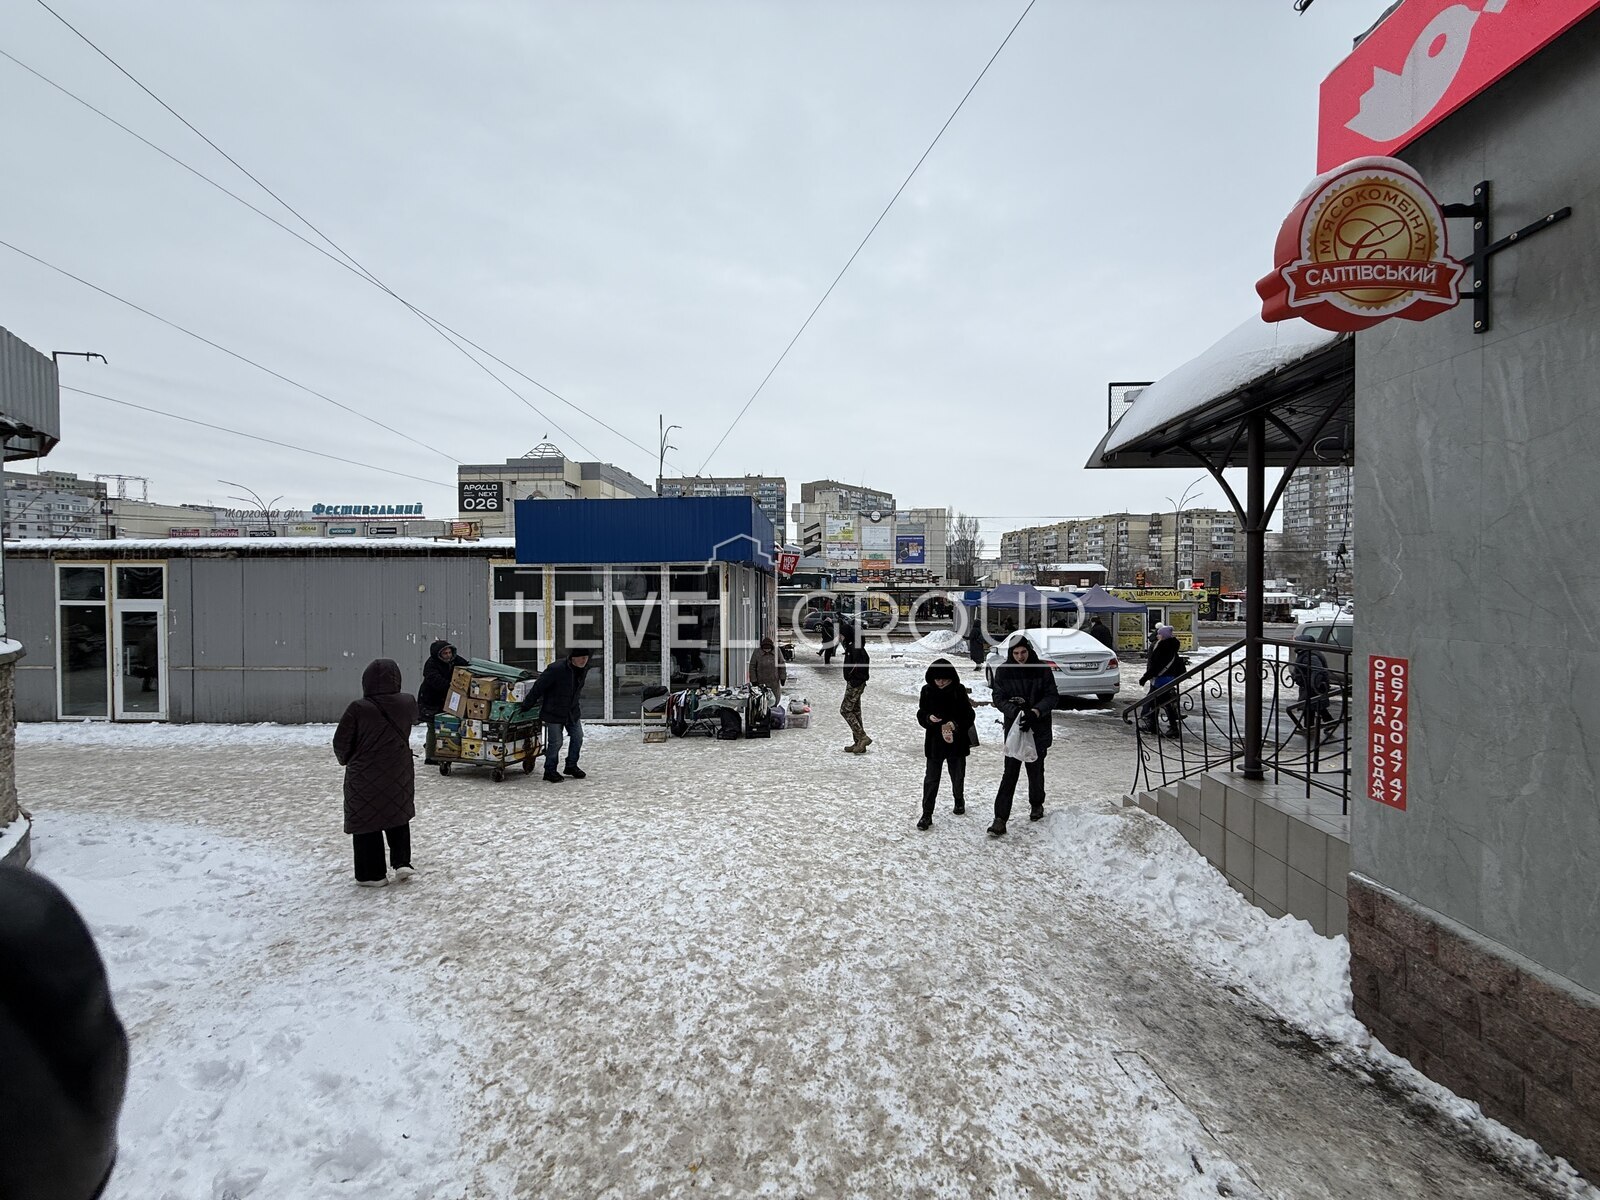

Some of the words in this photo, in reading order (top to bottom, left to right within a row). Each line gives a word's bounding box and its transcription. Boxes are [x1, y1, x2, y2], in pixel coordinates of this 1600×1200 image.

[1320, 189, 1427, 255] М'ЯСОКОМБІНАТ
[1305, 263, 1438, 286] САЛТІВСЬКИЙ
[311, 501, 424, 516] Фестивальний
[463, 498, 498, 510] 026
[1373, 659, 1387, 727] ОРЕНДА
[1372, 733, 1386, 801] ПРОДАЖ
